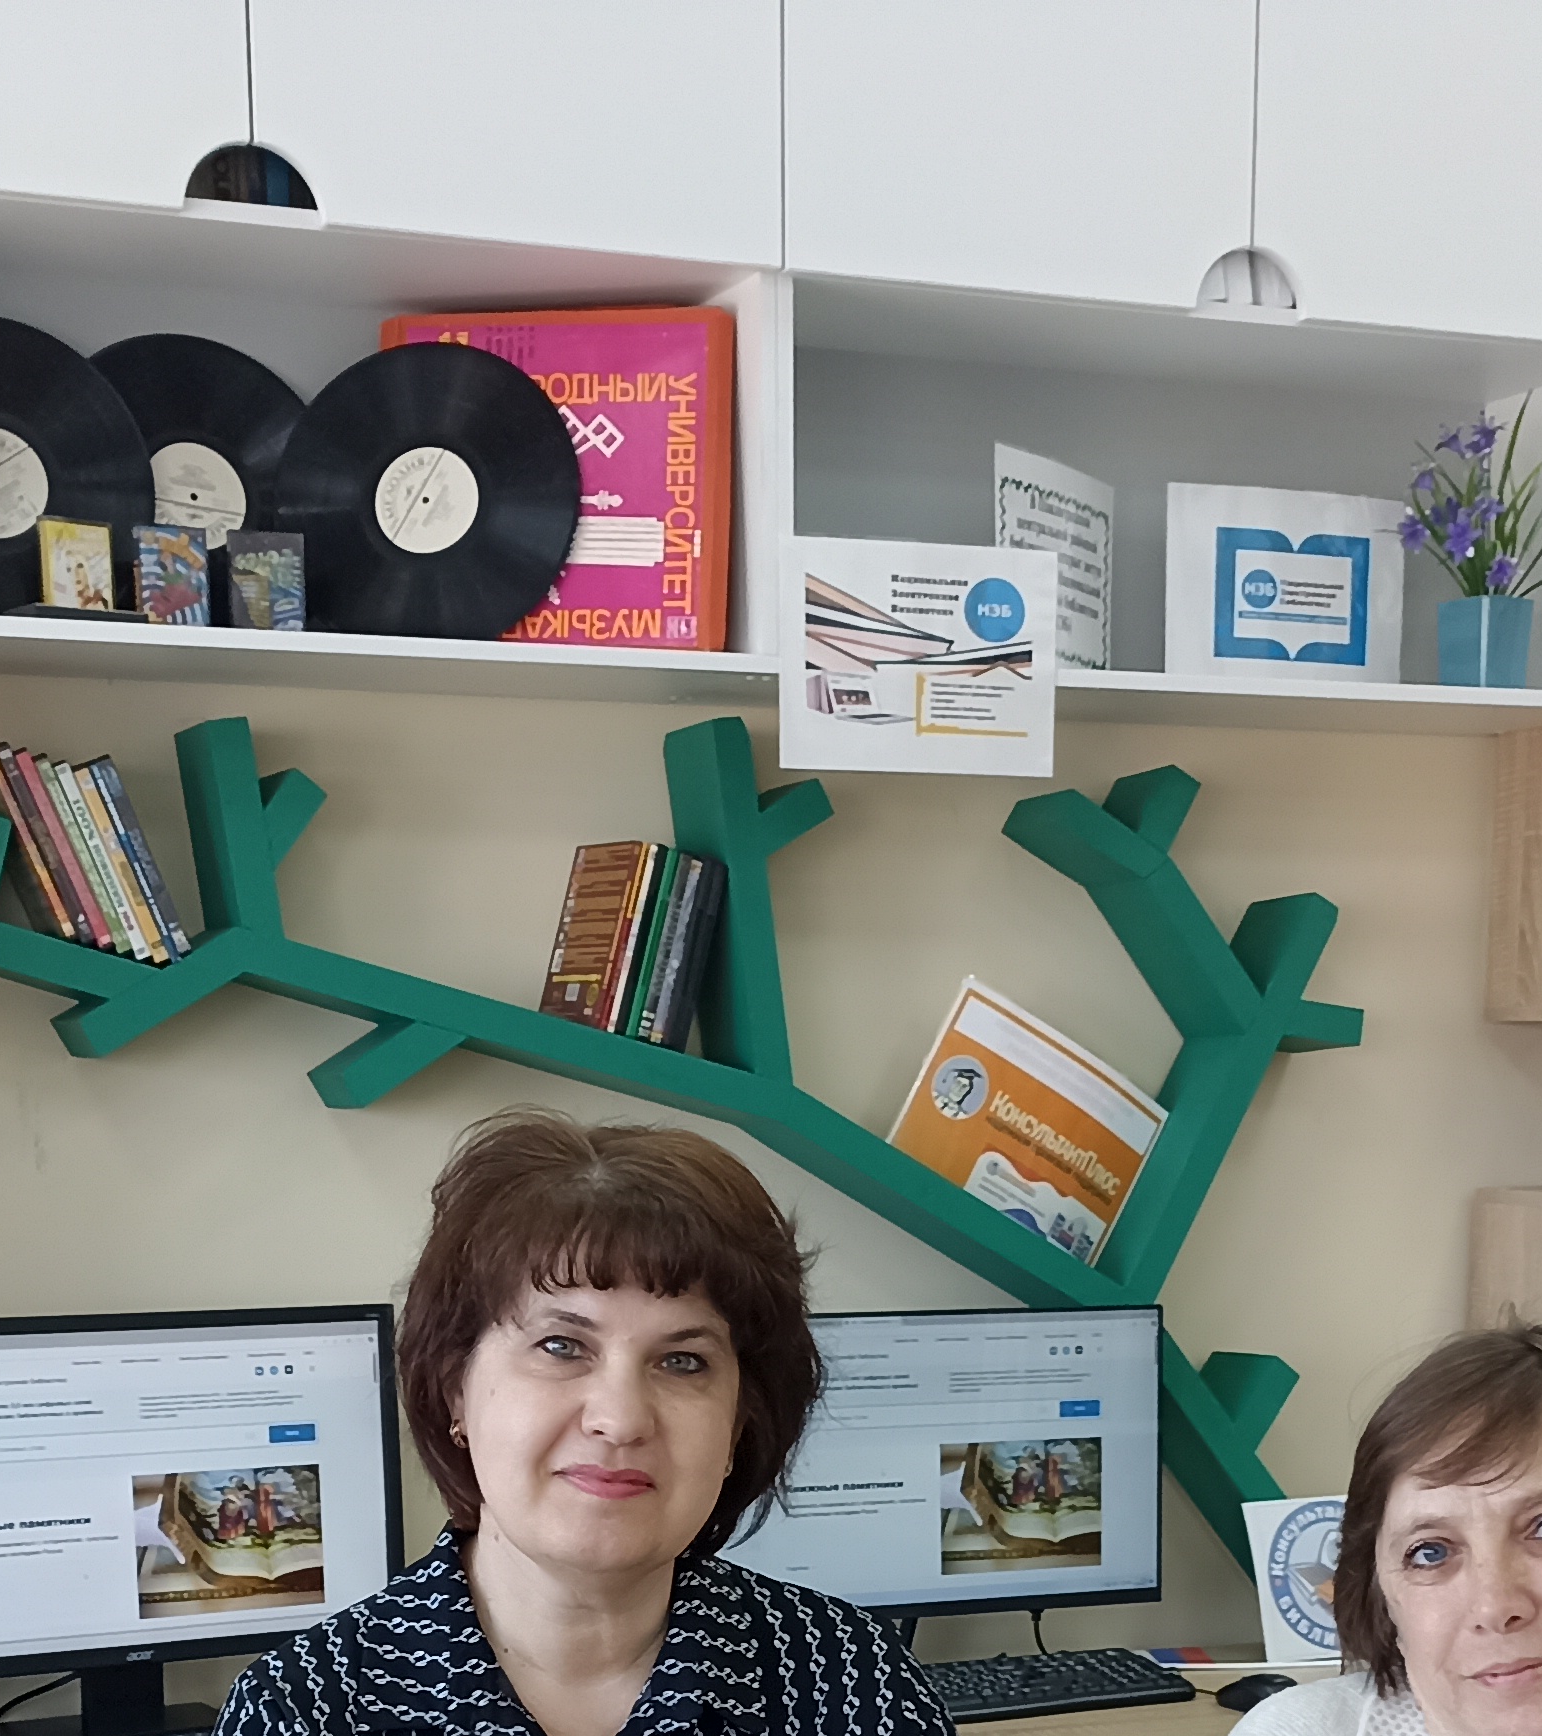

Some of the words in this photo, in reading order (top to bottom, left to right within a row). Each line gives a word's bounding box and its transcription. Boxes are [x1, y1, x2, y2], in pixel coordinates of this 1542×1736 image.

[663, 372, 698, 615] УНИВЕРСИТЕТ
[1244, 581, 1276, 597] НЭБ
[977, 603, 1013, 618] НЭБ
